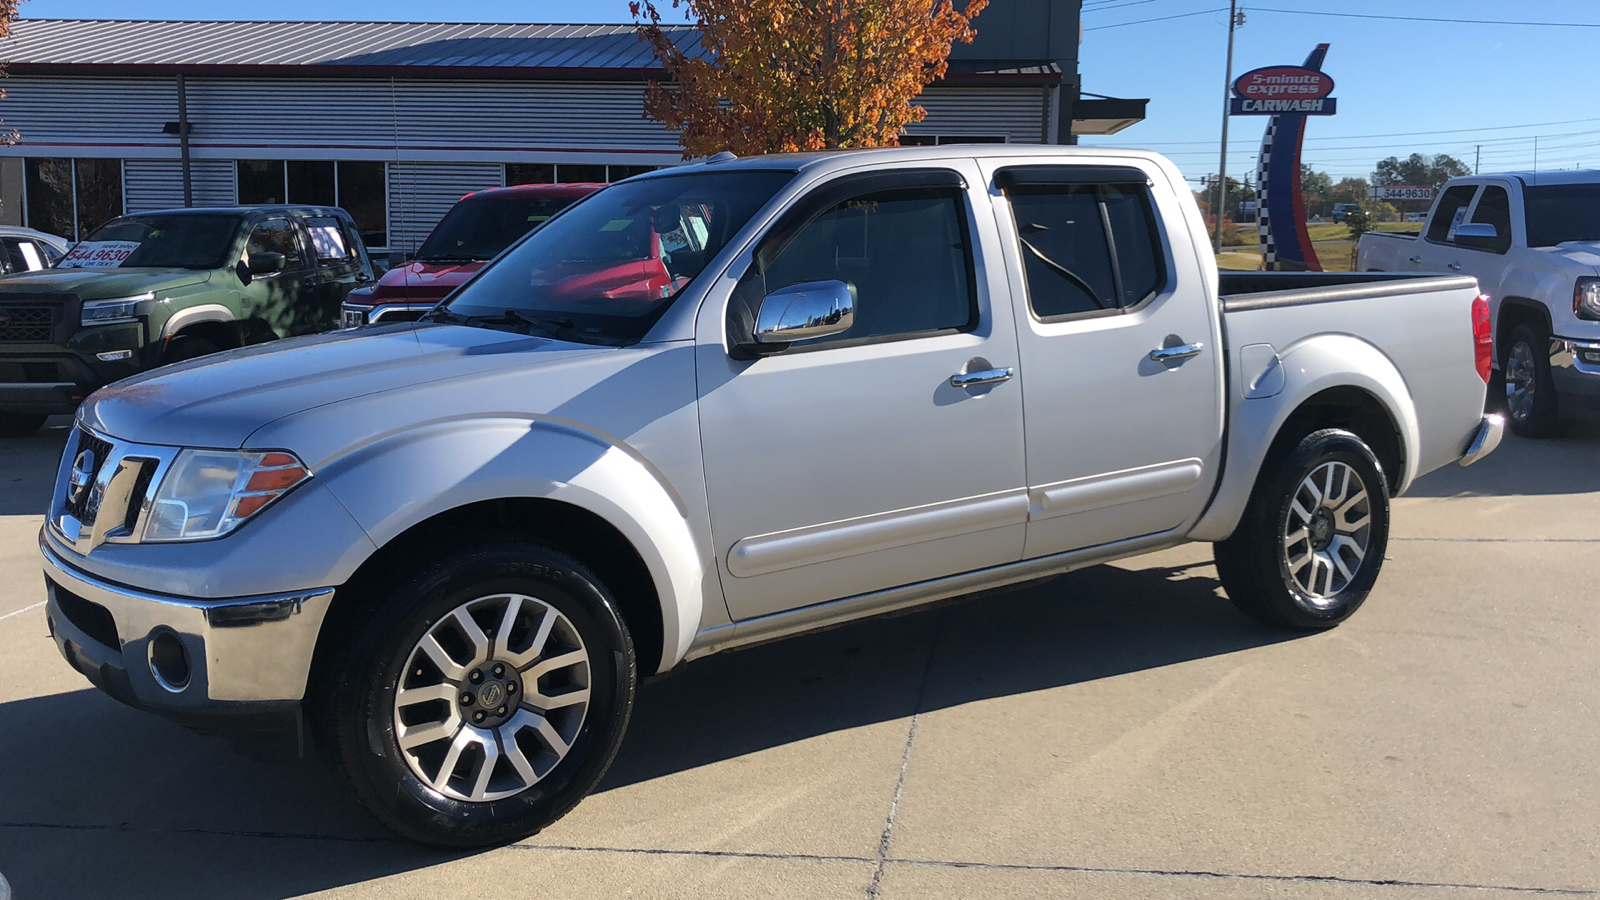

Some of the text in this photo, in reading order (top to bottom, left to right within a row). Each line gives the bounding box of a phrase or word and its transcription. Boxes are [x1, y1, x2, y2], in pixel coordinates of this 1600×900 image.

[1252, 74, 1320, 84] 5-minute
[1246, 84, 1319, 96] express
[1241, 99, 1324, 112] CARWASH
[1384, 188, 1430, 198] 544-9630
